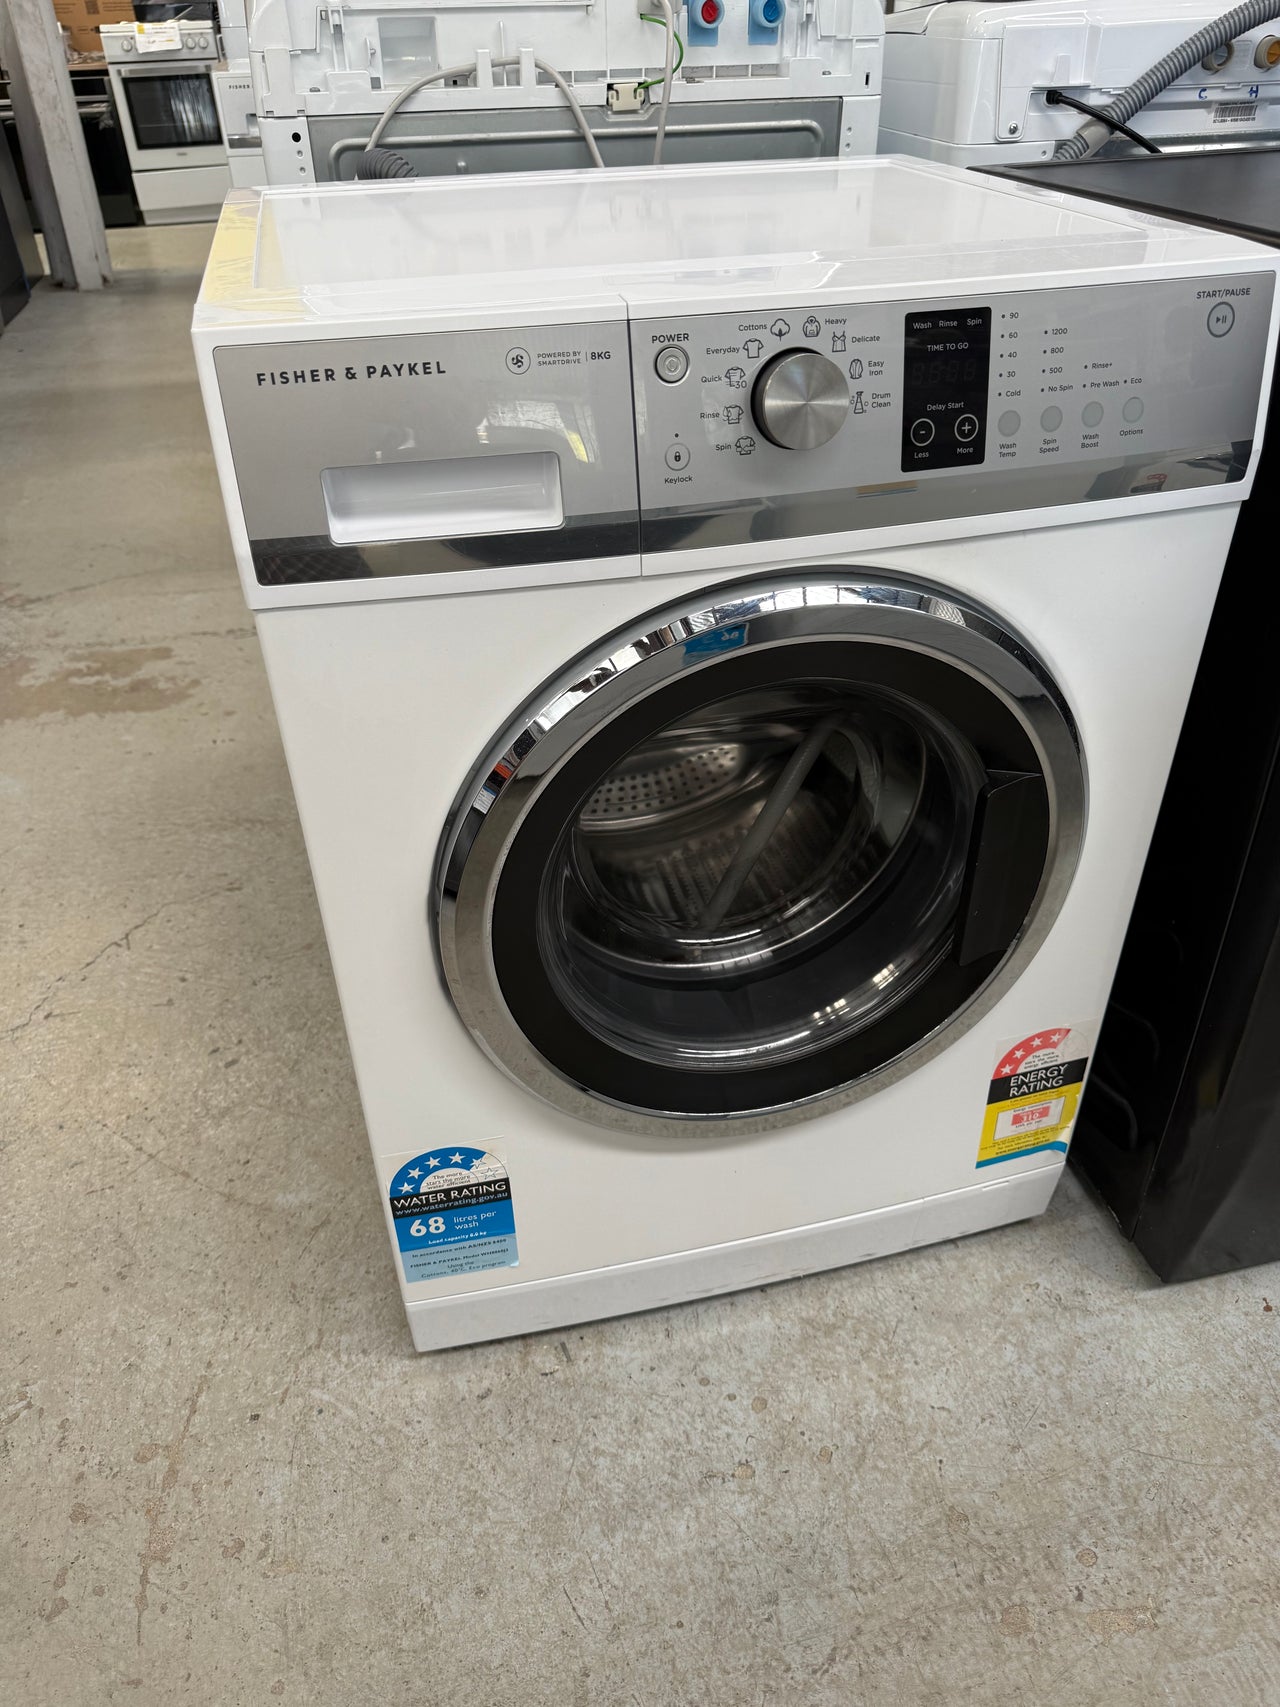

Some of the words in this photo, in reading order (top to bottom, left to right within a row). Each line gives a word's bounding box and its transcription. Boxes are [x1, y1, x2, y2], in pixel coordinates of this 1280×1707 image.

[1198, 88, 1208, 100] C
[1248, 84, 1258, 98] H
[1196, 288, 1251, 299] START/PAUSE
[825, 317, 847, 326] Heavy
[912, 321, 932, 330] Wash
[938, 319, 958, 328] Rinse
[966, 318, 982, 327] Spin
[738, 323, 768, 332] Cottons
[1052, 328, 1068, 336] 1200
[651, 333, 690, 344] POWER
[852, 334, 880, 343] Delicate
[706, 346, 740, 355] Everyday
[590, 351, 611, 360] 8KG
[538, 358, 581, 366] SMARTDRIVE
[868, 360, 884, 368] Easy
[1092, 361, 1113, 370] Rinse+
[256, 368, 336, 386] FISHER
[345, 367, 358, 380] &
[366, 360, 447, 378] PAYKEL
[869, 368, 884, 376] Iron
[1049, 366, 1063, 374] 500
[700, 374, 722, 384] Quick
[735, 380, 747, 388] 30
[1060, 383, 1074, 392] Spin
[1104, 380, 1120, 388] Wash
[872, 392, 891, 400] Drum
[1006, 390, 1022, 398] Cold
[872, 400, 891, 408] Clean
[926, 404, 946, 412] Delay
[947, 401, 964, 410] Start
[700, 411, 720, 420] Rinse
[1120, 428, 1144, 438] Options
[998, 442, 1017, 450] Wash
[1042, 438, 1057, 446] Spin
[1080, 441, 1099, 449] Boost
[716, 442, 732, 452] Spin
[956, 446, 974, 454] More
[1039, 446, 1060, 454] Speed
[914, 450, 930, 459] Less
[998, 450, 1016, 458] Temp
[664, 475, 692, 484] Keylock
[1010, 1064, 1068, 1086] ENERGY
[1010, 1076, 1063, 1097] RATING
[394, 1192, 446, 1208] WATER
[451, 1182, 506, 1199] RATING
[395, 1192, 508, 1216] www.waterrating.gov.au
[454, 1215, 478, 1224] litres
[480, 1211, 497, 1220] per
[410, 1216, 446, 1237] 68
[455, 1221, 479, 1230] wash
